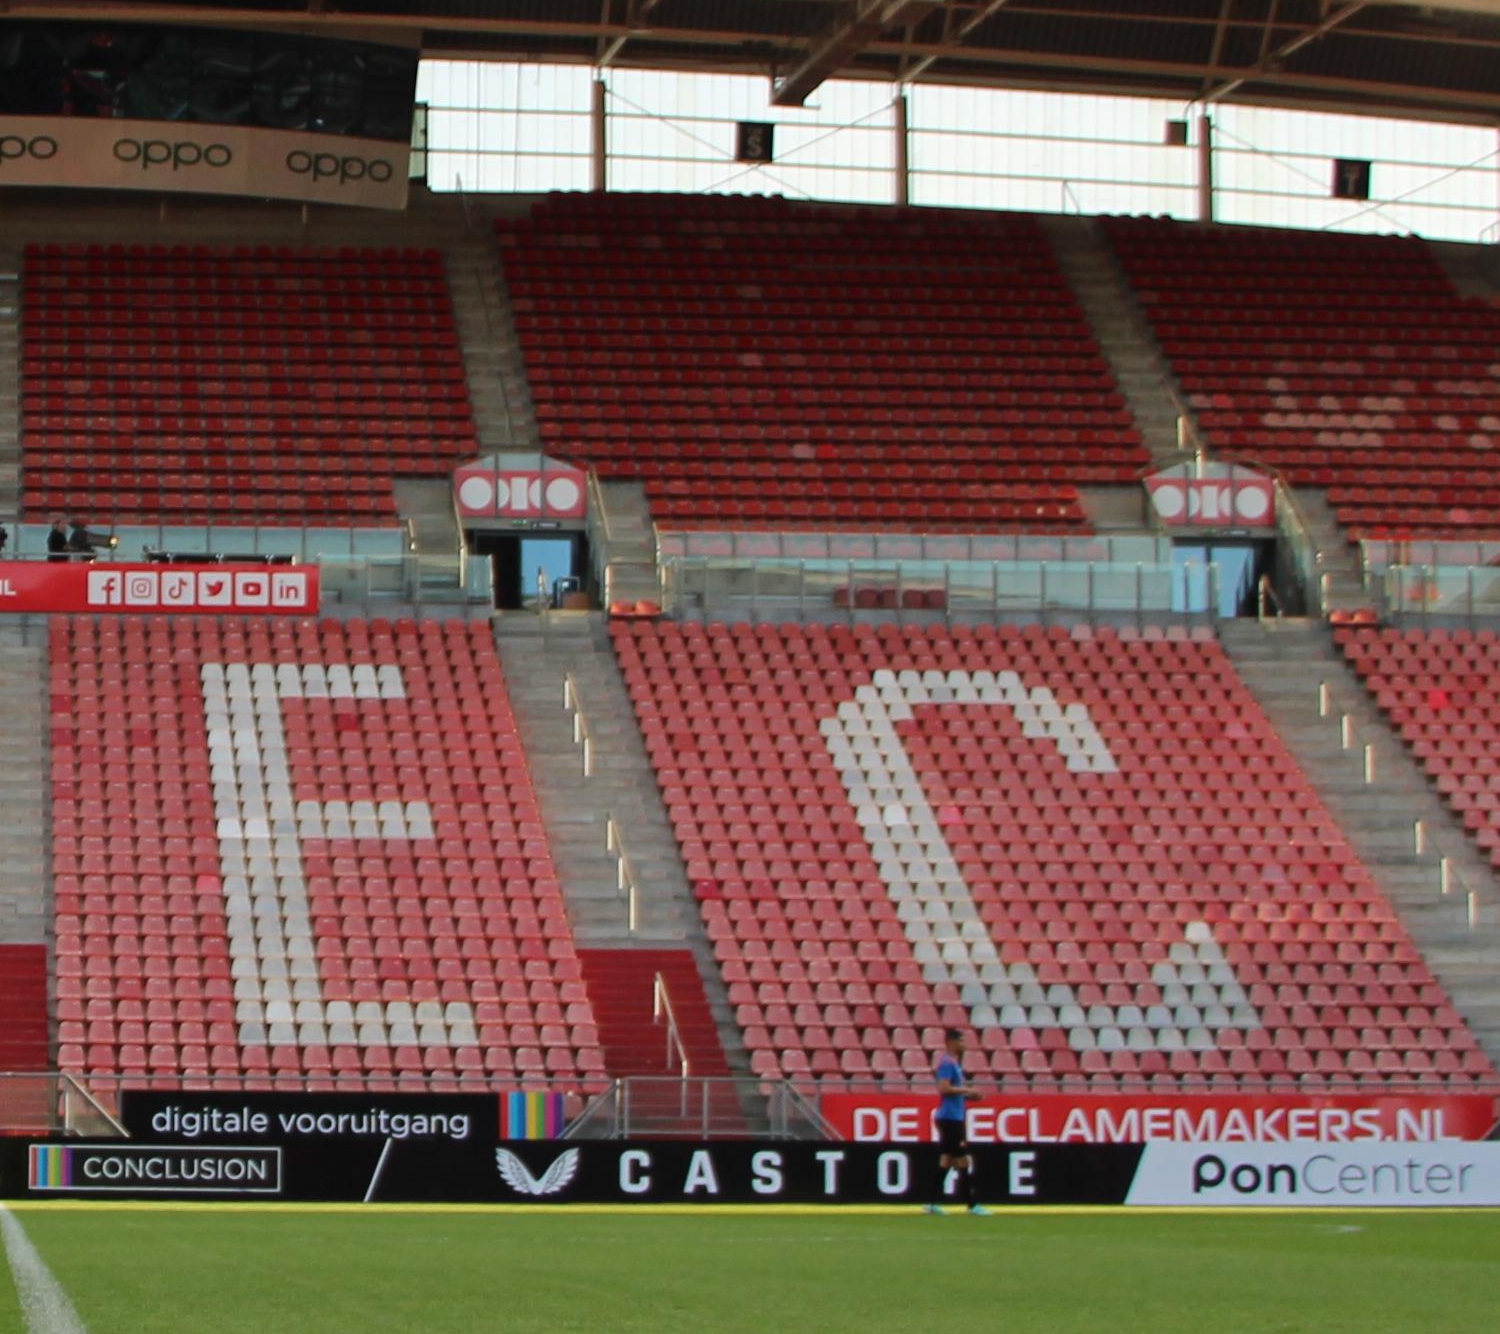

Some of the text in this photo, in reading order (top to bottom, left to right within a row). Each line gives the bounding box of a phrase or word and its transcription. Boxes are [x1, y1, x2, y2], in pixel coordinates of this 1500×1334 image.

[112, 138, 232, 171] oppo
[285, 149, 393, 185] oppo
[151, 1106, 470, 1138] digitale vooruitgang
[853, 1107, 918, 1142] DE
[83, 1156, 266, 1180] CONCLUSION
